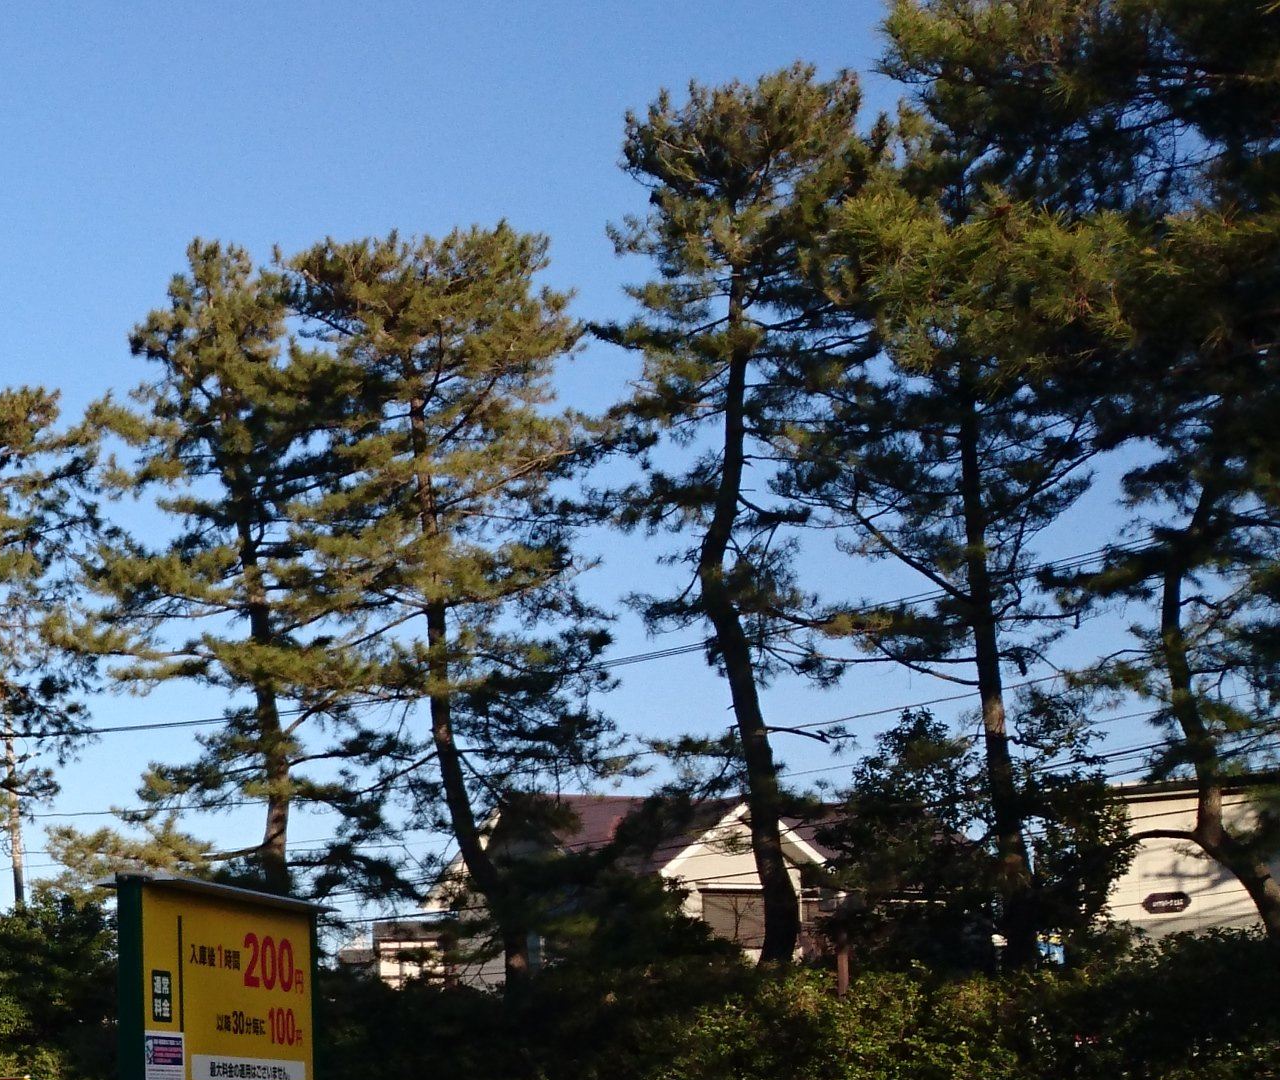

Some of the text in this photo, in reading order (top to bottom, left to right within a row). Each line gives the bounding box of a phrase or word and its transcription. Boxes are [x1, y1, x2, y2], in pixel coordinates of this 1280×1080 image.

[190, 932, 304, 995] 入庫後1時間 200円
[153, 976, 170, 995] 通常
[154, 998, 171, 1017] 料金
[268, 1007, 304, 1047] 100円
